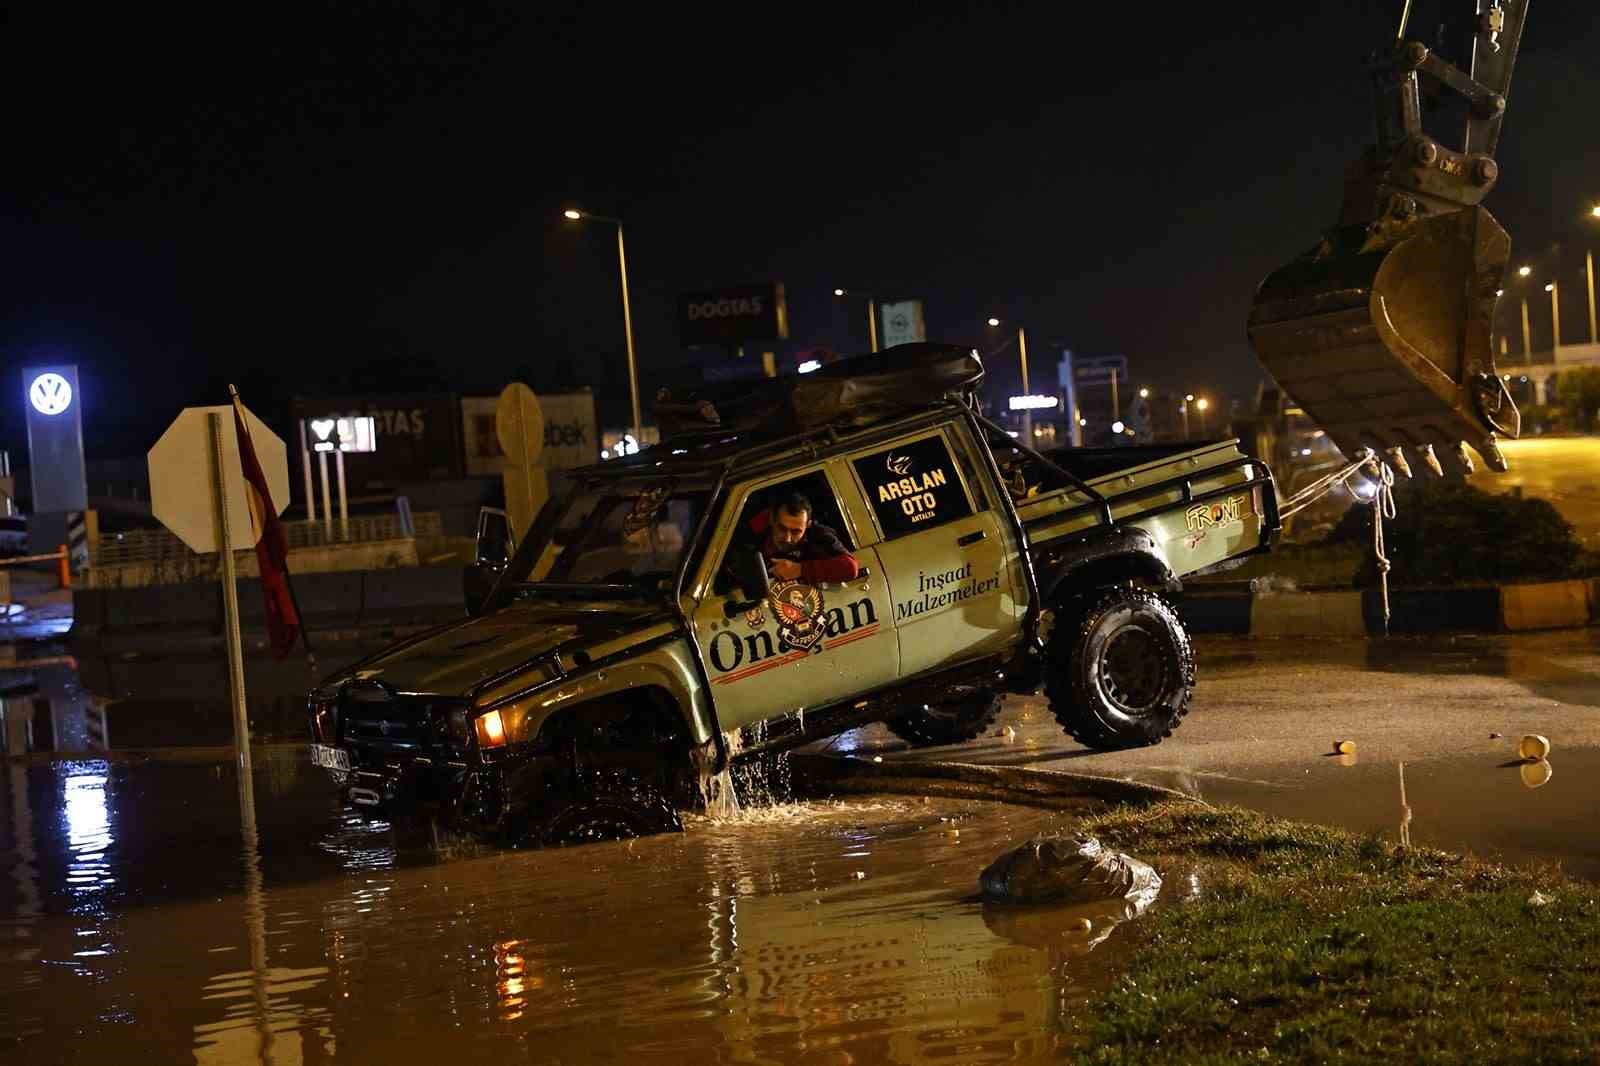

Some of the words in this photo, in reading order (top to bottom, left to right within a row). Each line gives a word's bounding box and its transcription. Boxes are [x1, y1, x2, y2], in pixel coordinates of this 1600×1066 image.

[878, 468, 947, 503] ARSLAN
[901, 492, 936, 516] OTO
[1185, 496, 1245, 530] FRONT
[918, 562, 973, 592] İnşaat
[896, 571, 1000, 621] Malzemeleri
[709, 597, 878, 673] Önan
